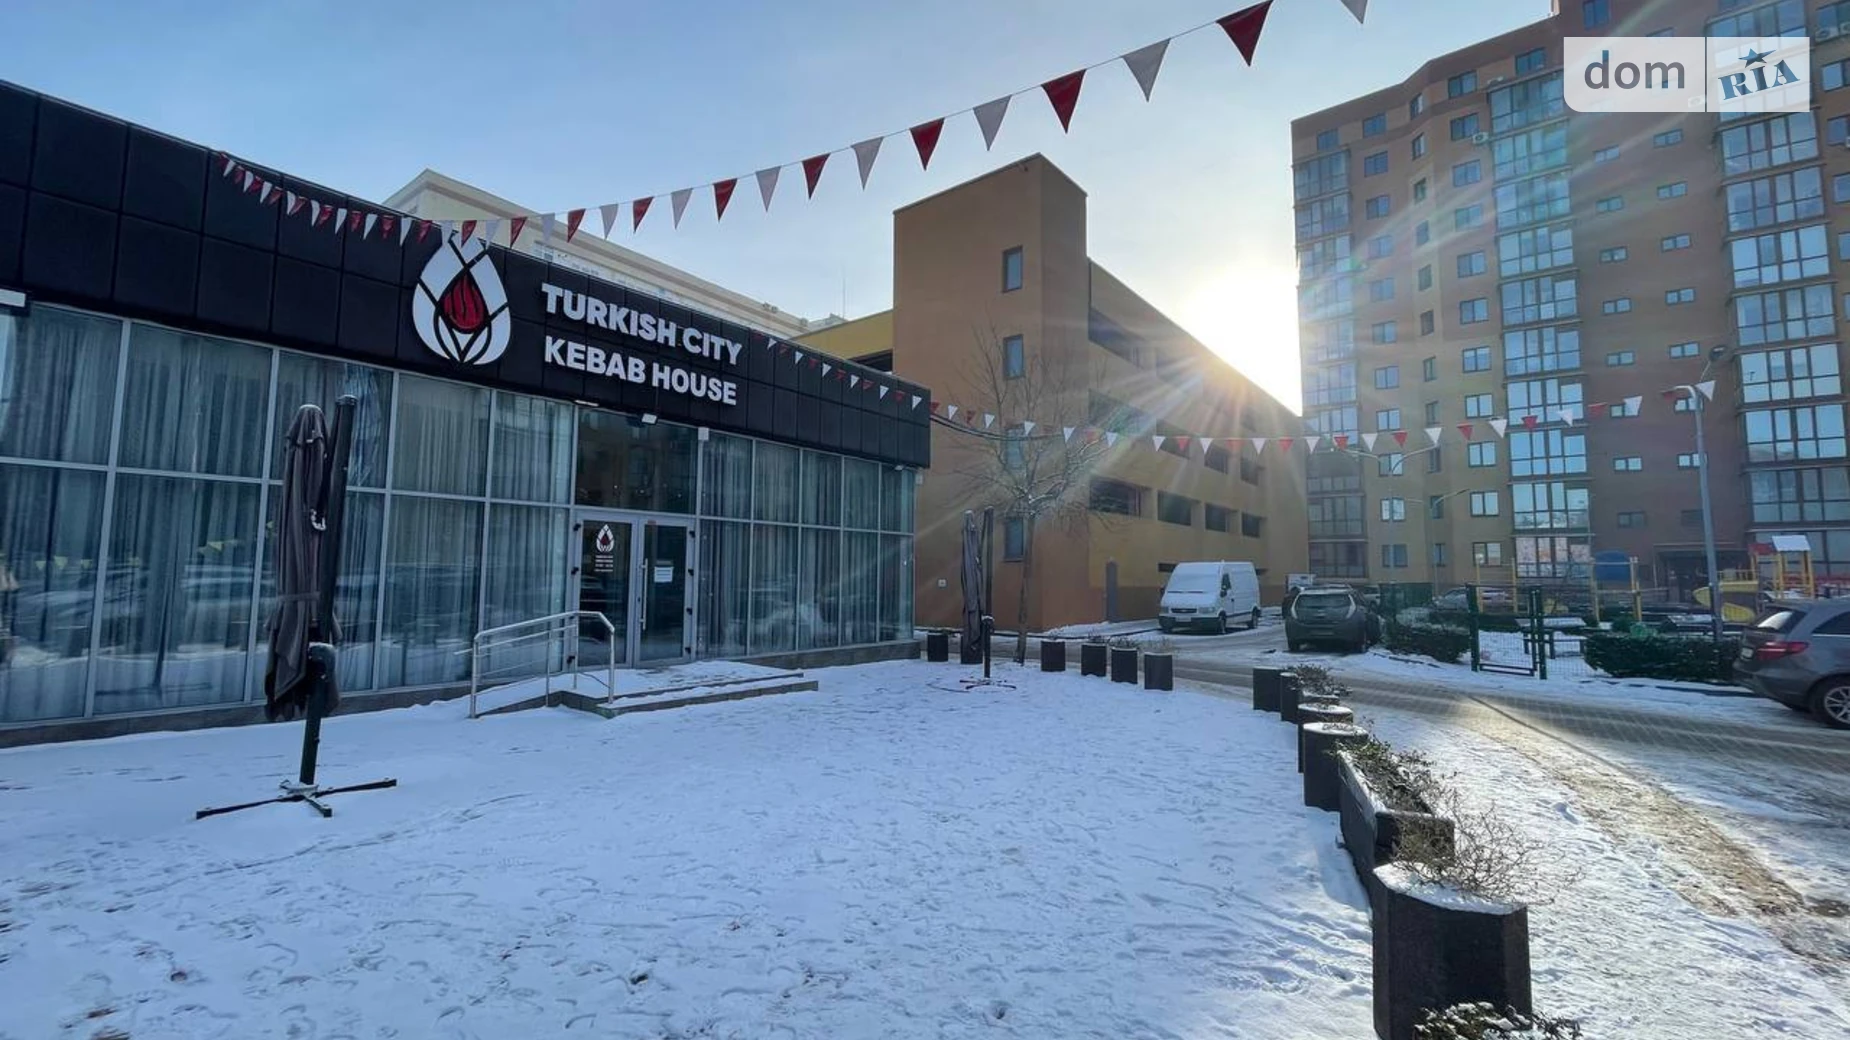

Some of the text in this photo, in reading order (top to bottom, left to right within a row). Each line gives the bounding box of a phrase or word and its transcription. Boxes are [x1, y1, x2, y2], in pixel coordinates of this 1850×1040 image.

[541, 282, 743, 366] TURKISH CITY
[544, 335, 737, 406] KEBAB HOUSE
